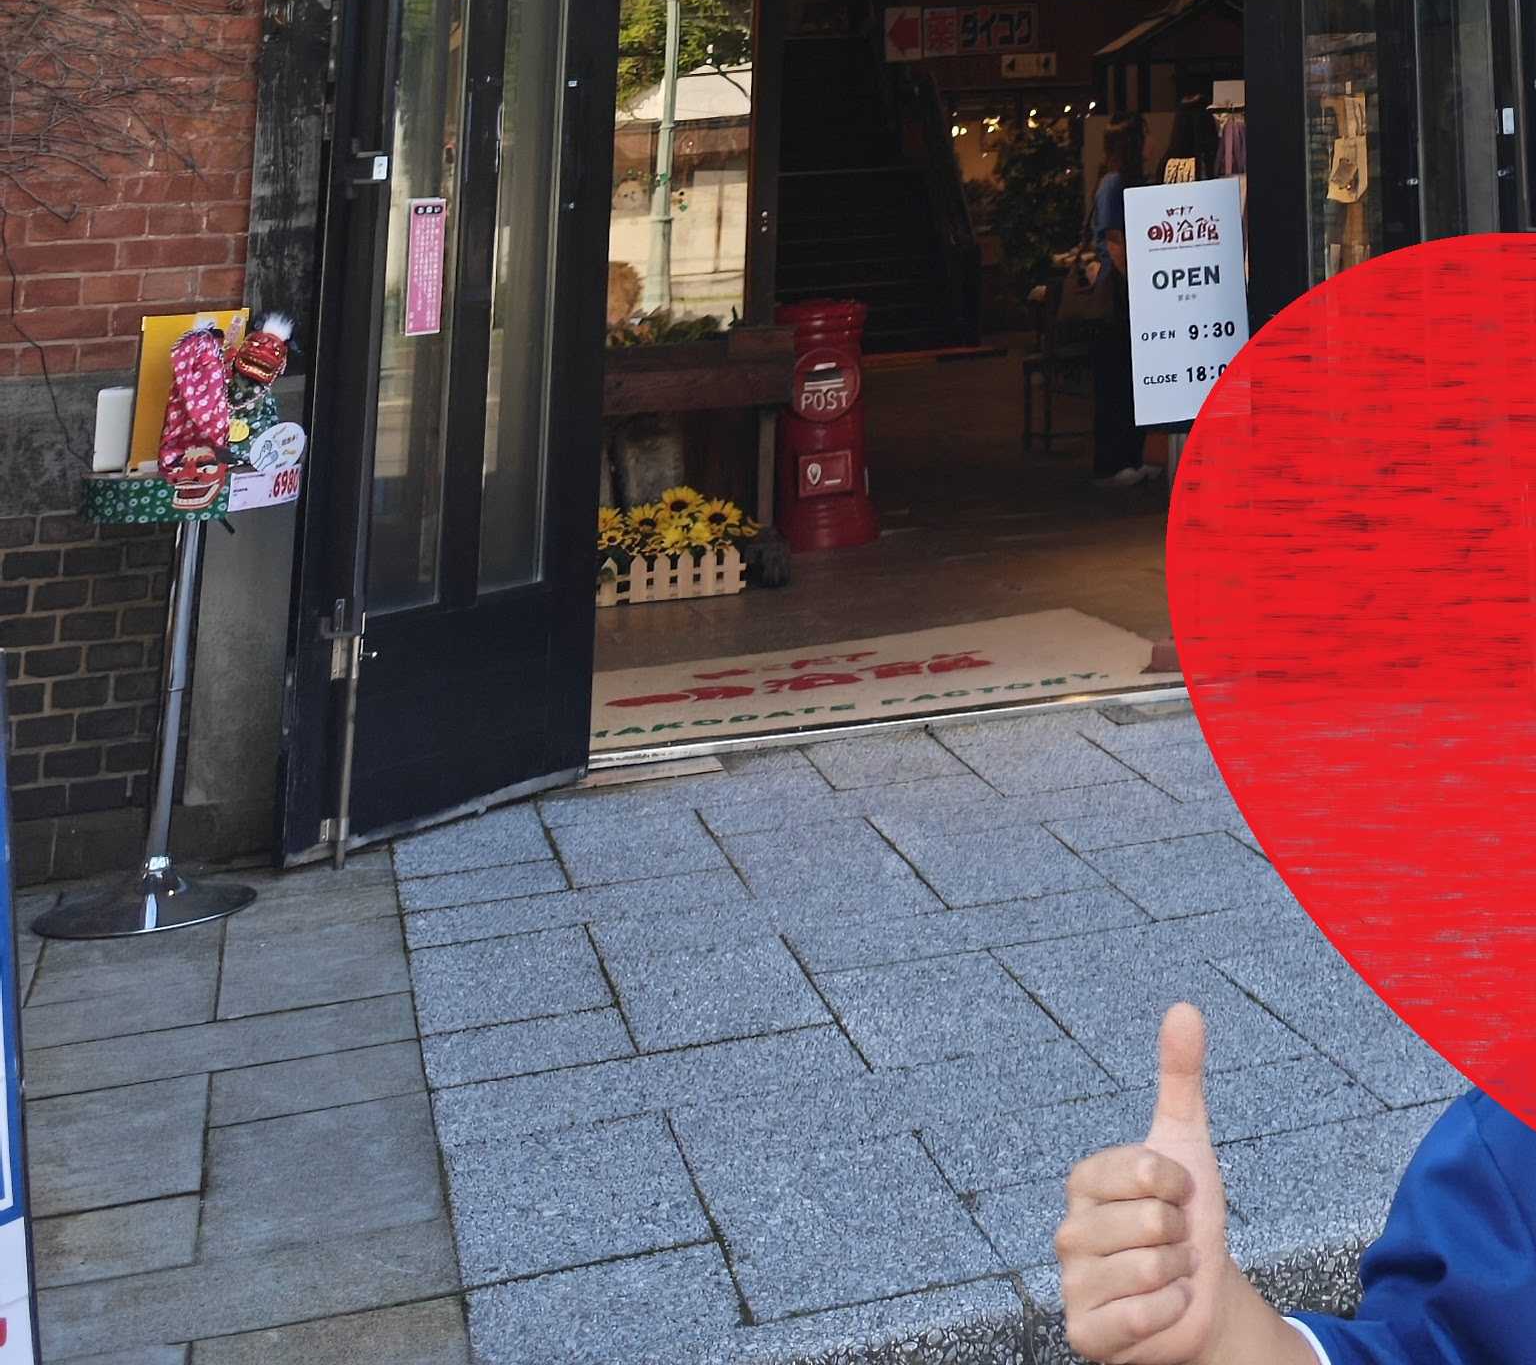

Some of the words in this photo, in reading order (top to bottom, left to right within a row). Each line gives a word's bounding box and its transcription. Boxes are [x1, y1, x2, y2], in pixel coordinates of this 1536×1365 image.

[1147, 215, 1220, 243] 明治館
[1152, 265, 1220, 290] OPEN
[1141, 330, 1176, 341] OPEN
[1188, 321, 1235, 340] 9:30
[1143, 373, 1178, 385] CLOSE
[1187, 364, 1227, 382] 18:0
[801, 390, 850, 411] POST
